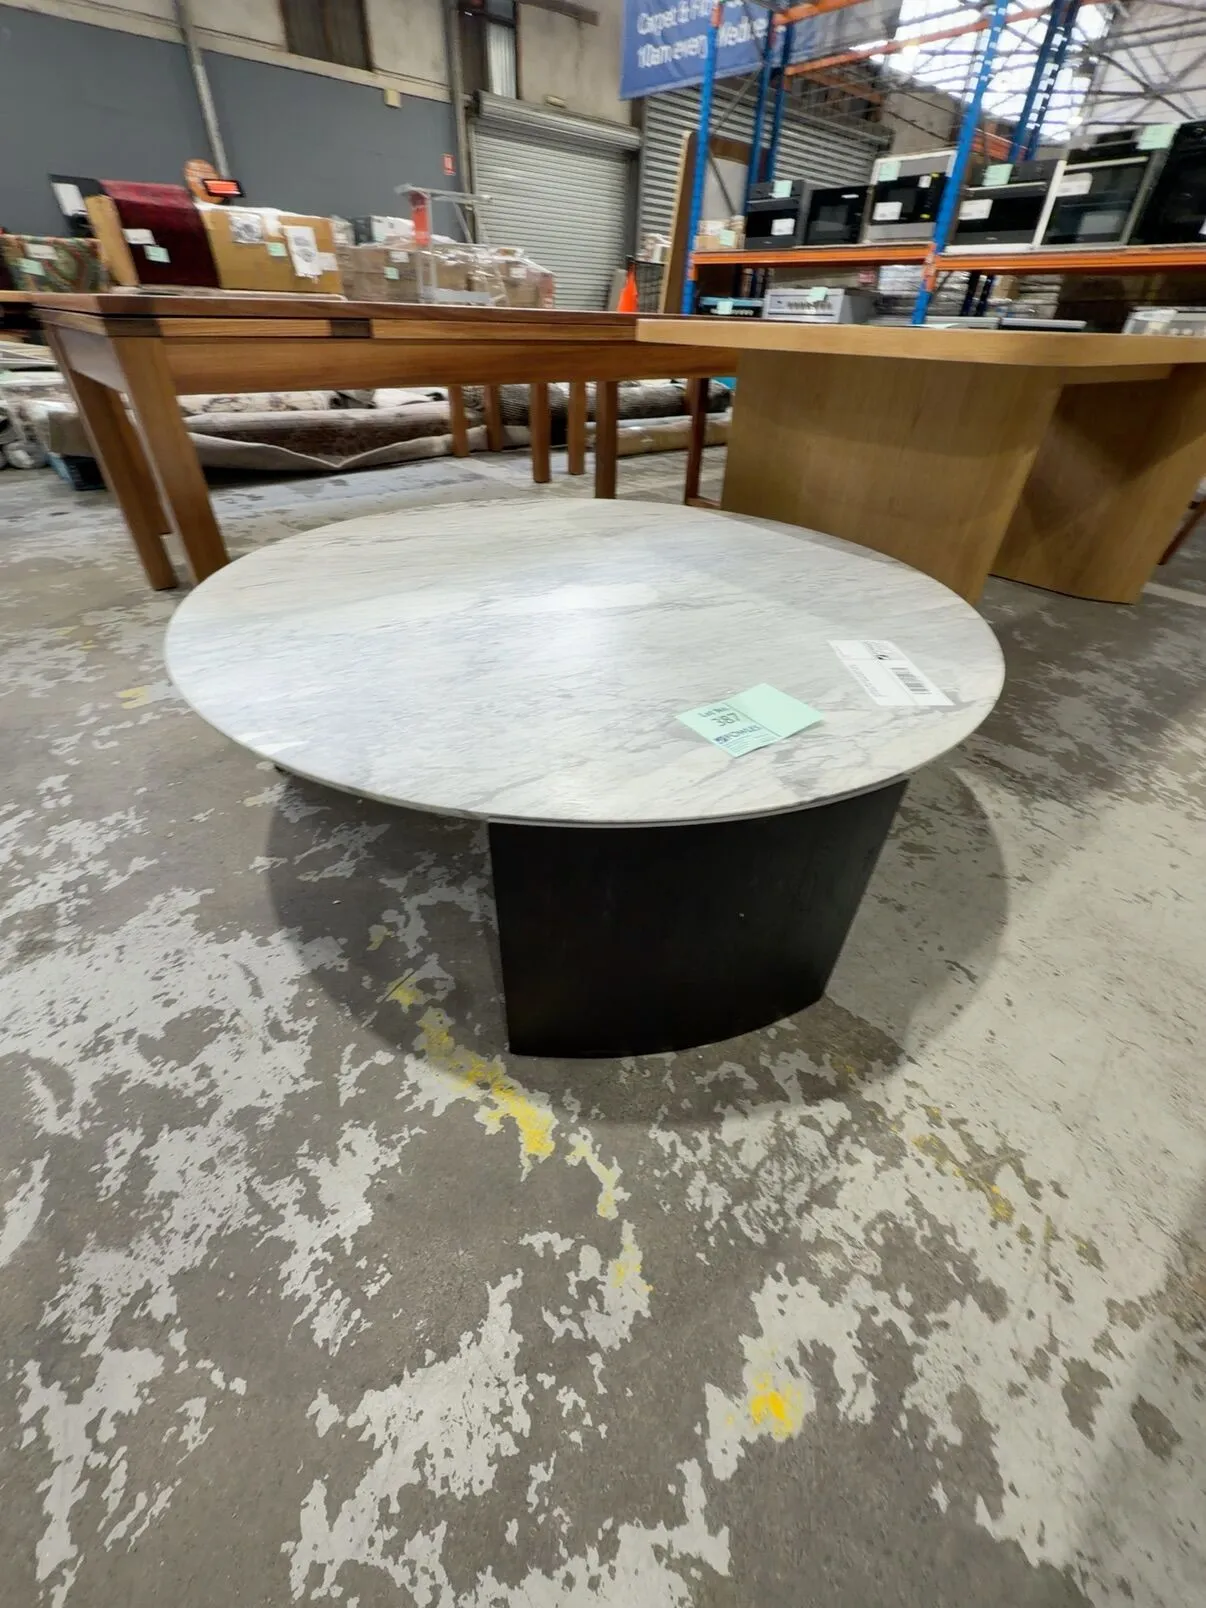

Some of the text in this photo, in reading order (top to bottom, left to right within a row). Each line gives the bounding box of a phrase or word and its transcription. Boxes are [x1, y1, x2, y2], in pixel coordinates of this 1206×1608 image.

[637, 9, 677, 35] Carpet
[671, 34, 708, 59] every
[711, 713, 741, 727] 387
